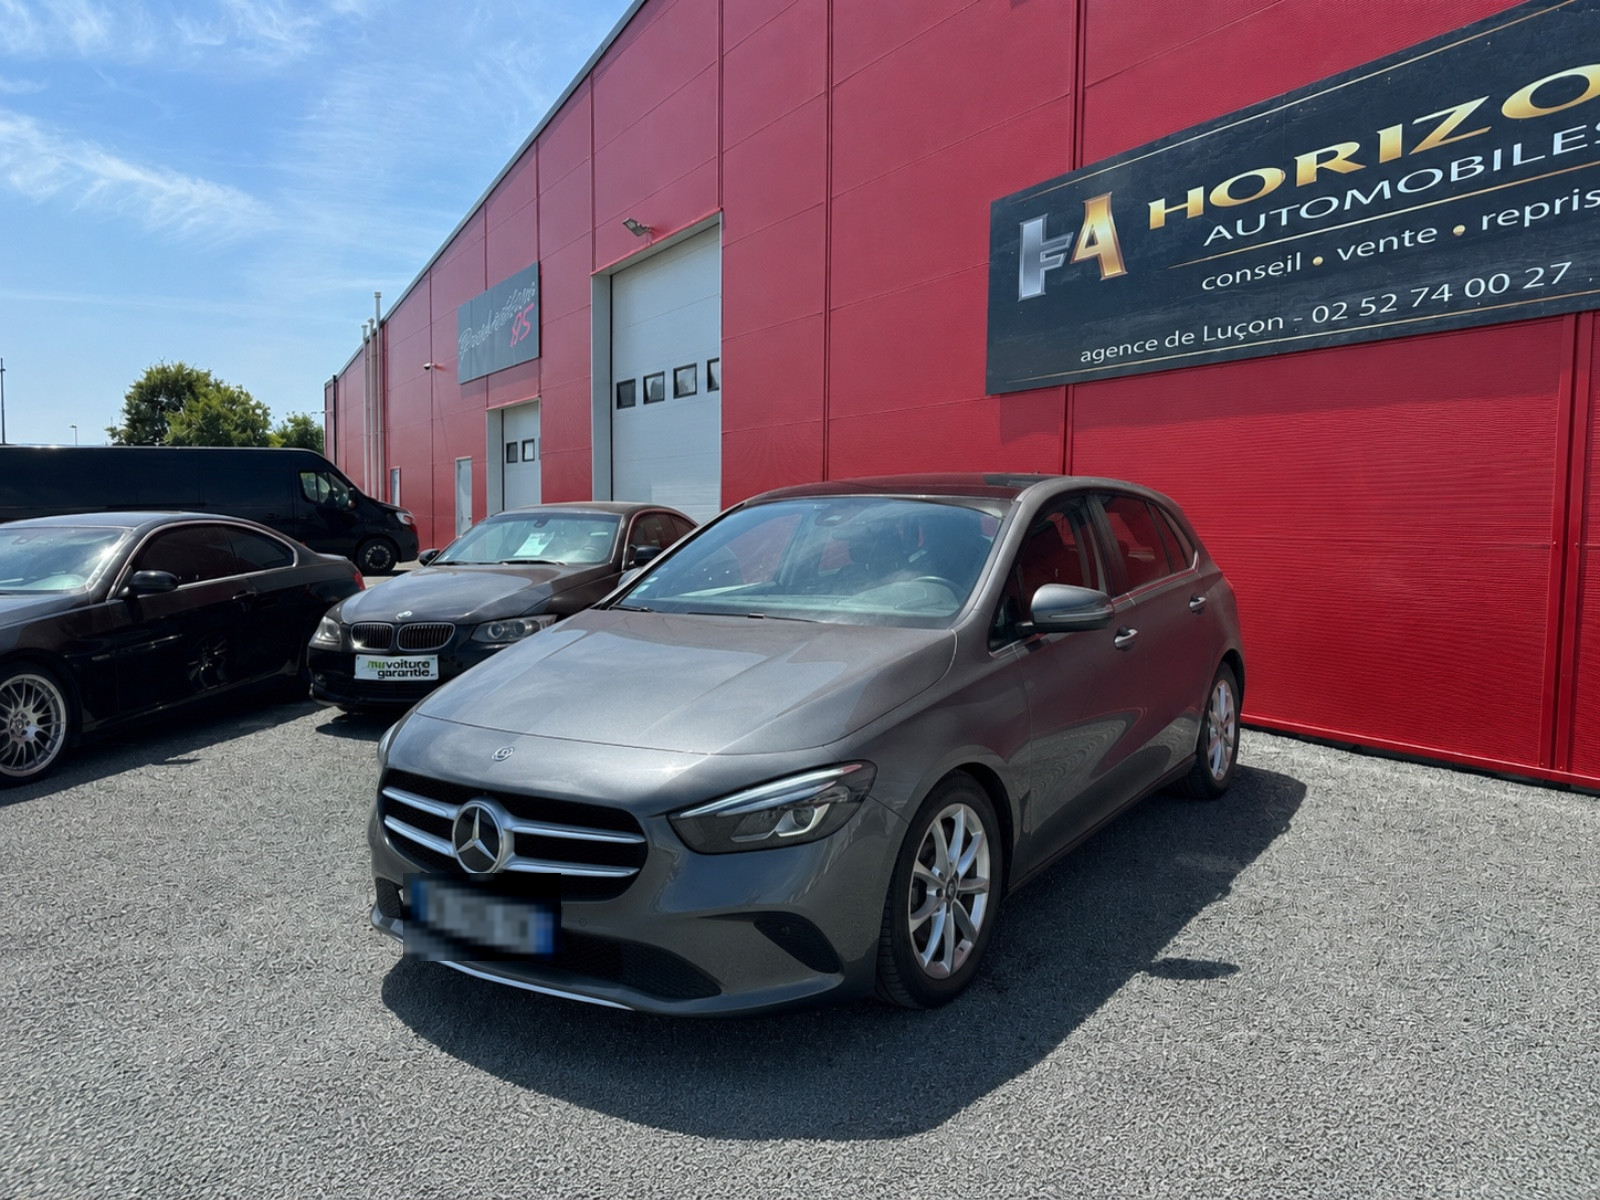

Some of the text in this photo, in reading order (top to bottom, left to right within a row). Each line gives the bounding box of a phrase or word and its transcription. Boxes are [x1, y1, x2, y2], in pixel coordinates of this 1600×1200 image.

[1201, 252, 1301, 290] conseil
[1336, 228, 1438, 261] vente
[1080, 338, 1158, 364] agence
[1164, 330, 1195, 348] de
[1203, 315, 1283, 341] Luçon
[1312, 301, 1348, 324] 02
[1359, 292, 1398, 317] 52
[1410, 283, 1453, 308] 74
[1464, 273, 1511, 298] 00
[1522, 261, 1573, 290] 27
